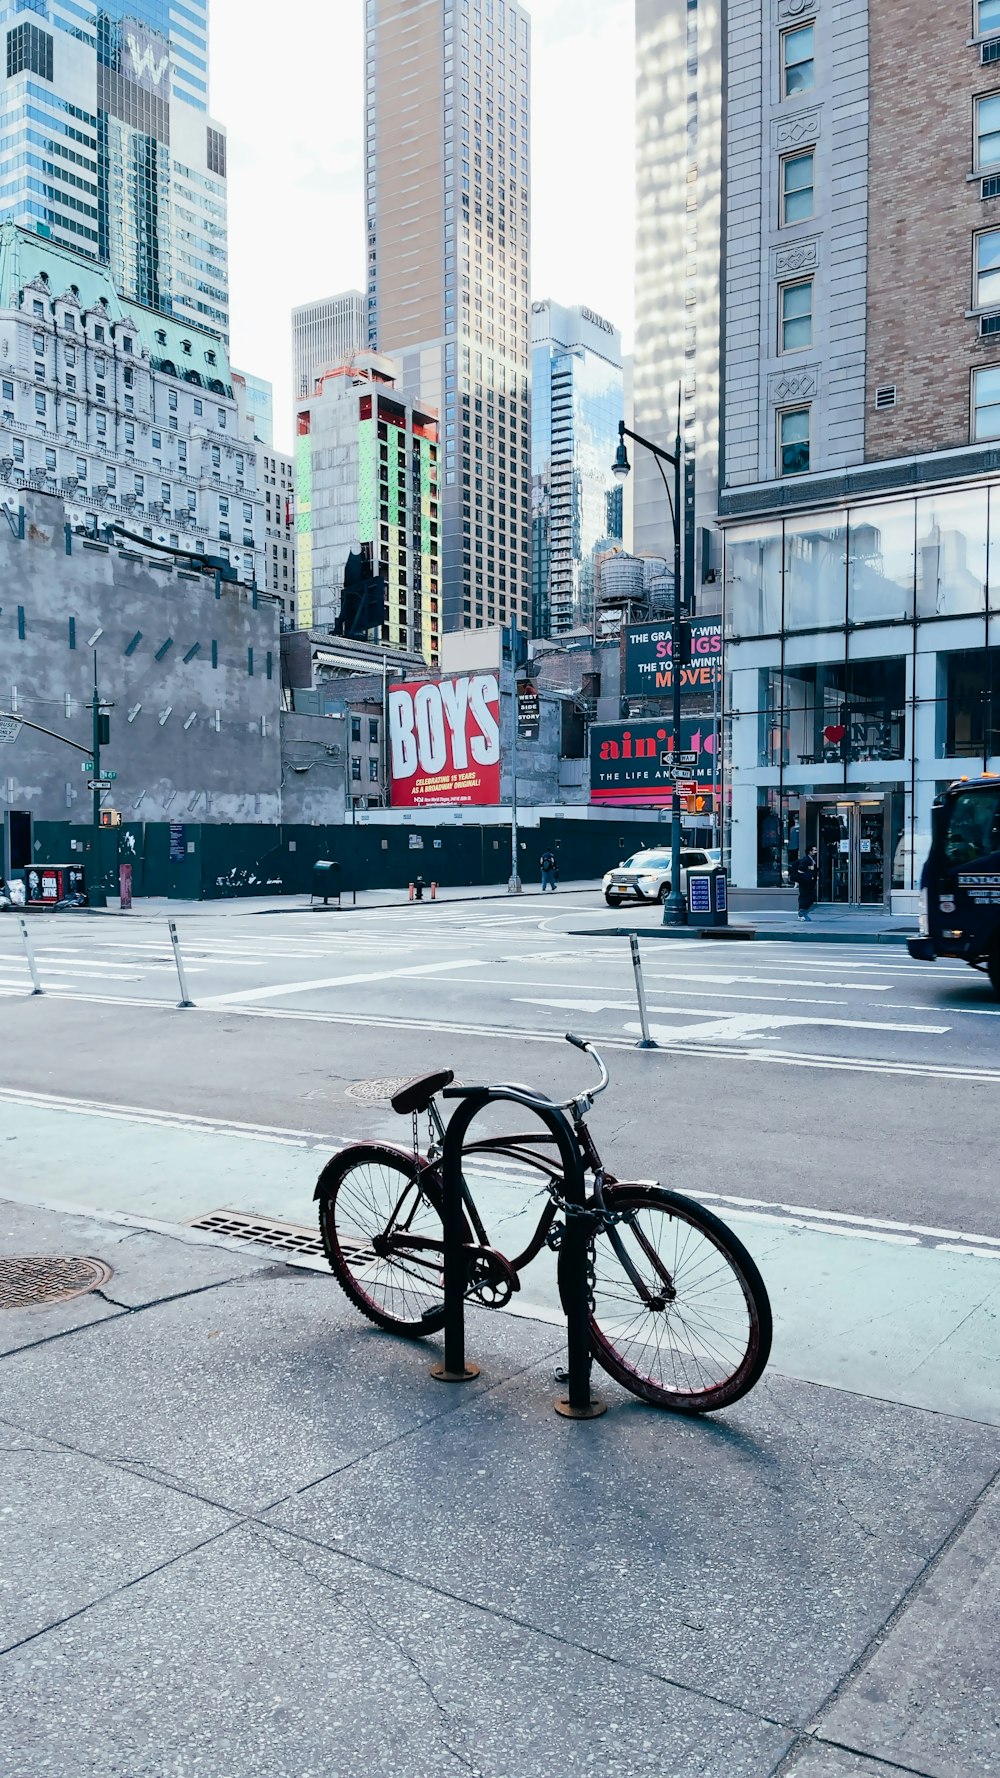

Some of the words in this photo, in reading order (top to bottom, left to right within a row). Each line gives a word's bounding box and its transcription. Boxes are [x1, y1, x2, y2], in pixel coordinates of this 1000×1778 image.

[127, 33, 169, 85] W
[630, 633, 649, 644] THE
[656, 635, 721, 658] SGS
[638, 662, 657, 673] THE
[388, 674, 500, 780] BOYS
[415, 776, 450, 787] CELEBRATING
[458, 772, 476, 781] YEARS
[600, 772, 620, 781] THE
[625, 770, 649, 780] LIFE
[655, 769, 670, 779] AN
[411, 787, 420, 795] AS
[425, 782, 453, 793] BROADWAY
[453, 779, 481, 790] ORIGINAL!
